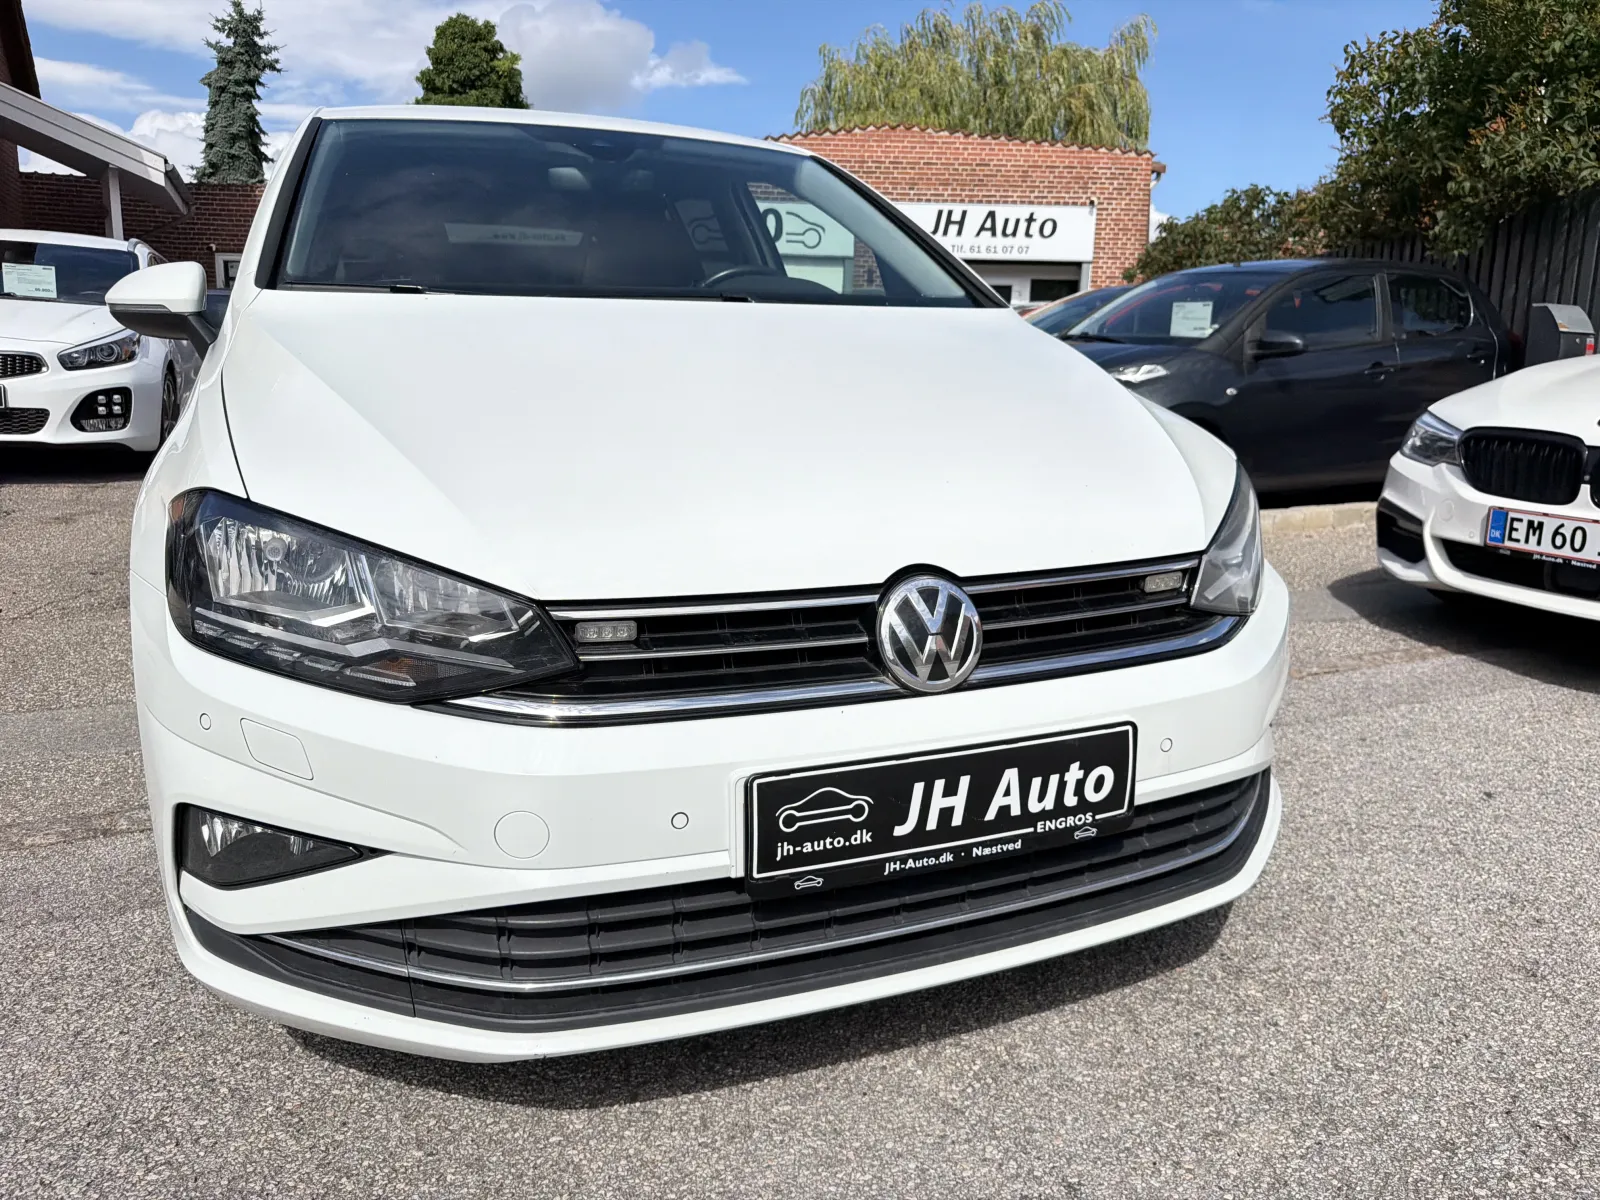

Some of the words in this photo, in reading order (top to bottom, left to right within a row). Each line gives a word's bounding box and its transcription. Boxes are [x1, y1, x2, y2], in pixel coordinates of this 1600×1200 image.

[931, 208, 968, 238] JH
[975, 209, 1058, 240] Auto
[950, 244, 966, 254] Tlf.
[969, 245, 982, 255] 61
[985, 245, 999, 255] 61
[1001, 245, 1014, 255] 07
[1017, 246, 1030, 256] 07
[1490, 528, 1502, 539] DK
[1507, 517, 1544, 546] EM
[1551, 523, 1587, 552] 60
[892, 774, 972, 837] JH
[984, 760, 1115, 821] Auto
[1035, 811, 1094, 834] ENGROS
[775, 828, 873, 862] jh-auto.dk
[884, 851, 954, 876] JH-Auto.dk
[972, 839, 1022, 858] Næstved
